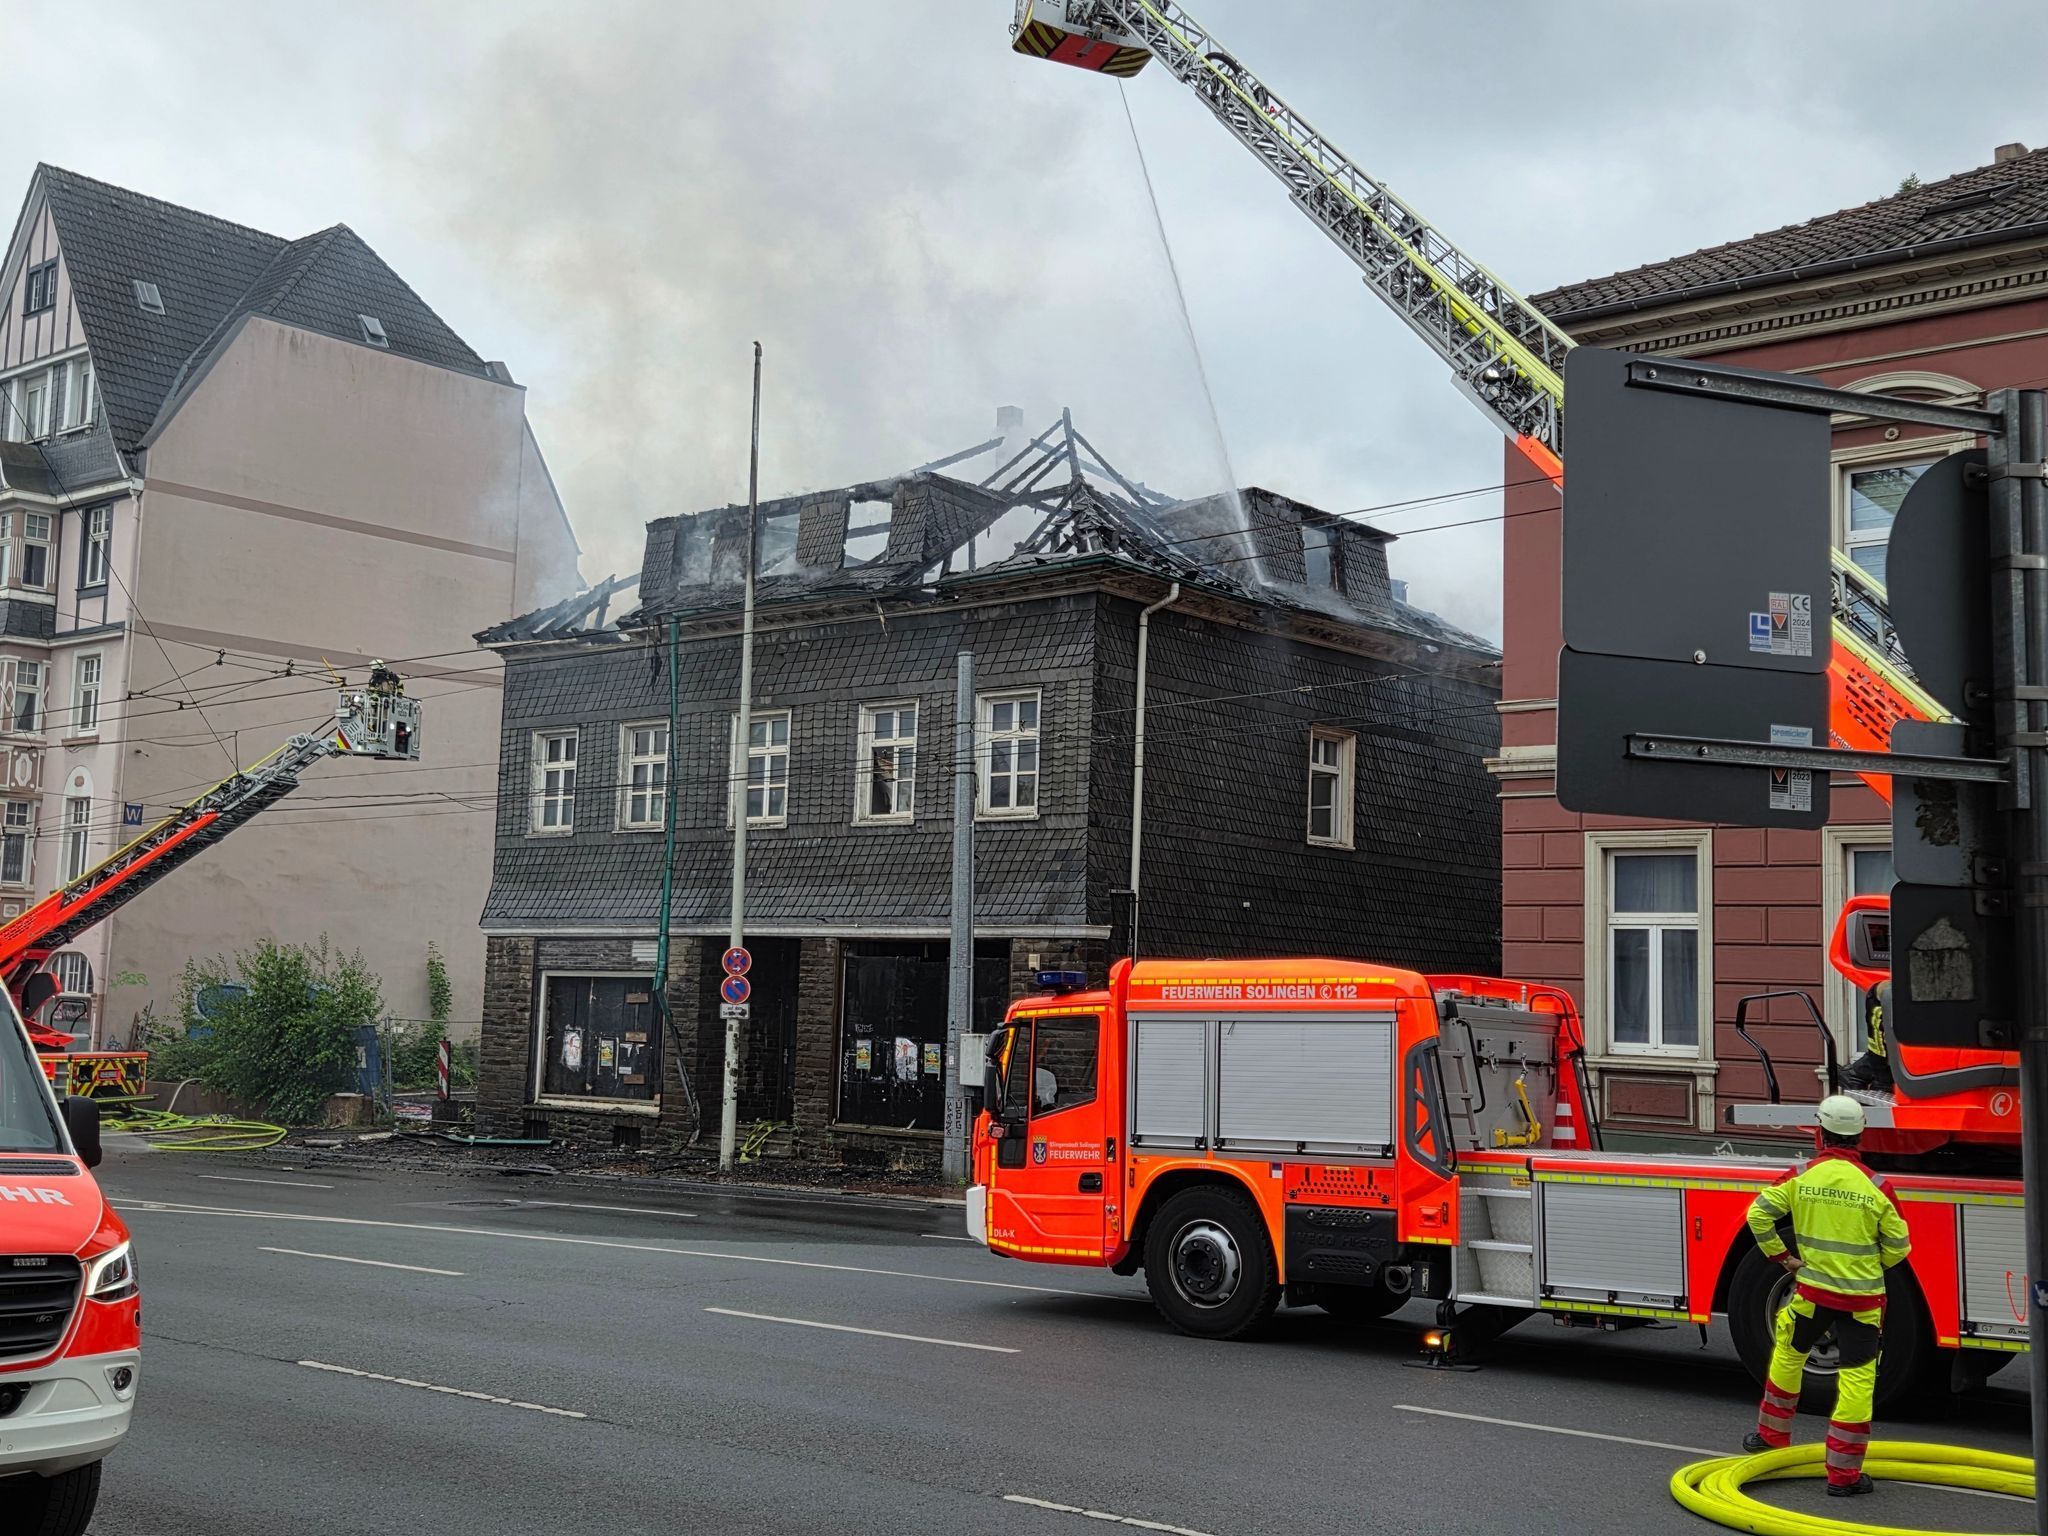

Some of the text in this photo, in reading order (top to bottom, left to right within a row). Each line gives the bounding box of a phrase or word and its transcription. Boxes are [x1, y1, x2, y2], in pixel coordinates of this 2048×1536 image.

[1792, 618, 1810, 627] 2024
[1792, 772, 1810, 781] 2023
[126, 807, 141, 821] W
[1161, 985, 1358, 1000] FEUERWEHR SOLINGEN 112
[1049, 1150, 1101, 1160] FEUERWEHR
[1798, 1186, 1875, 1206] FEUERWEHR
[993, 1228, 1016, 1238] DLA-K
[1981, 1324, 1993, 1332] G7
